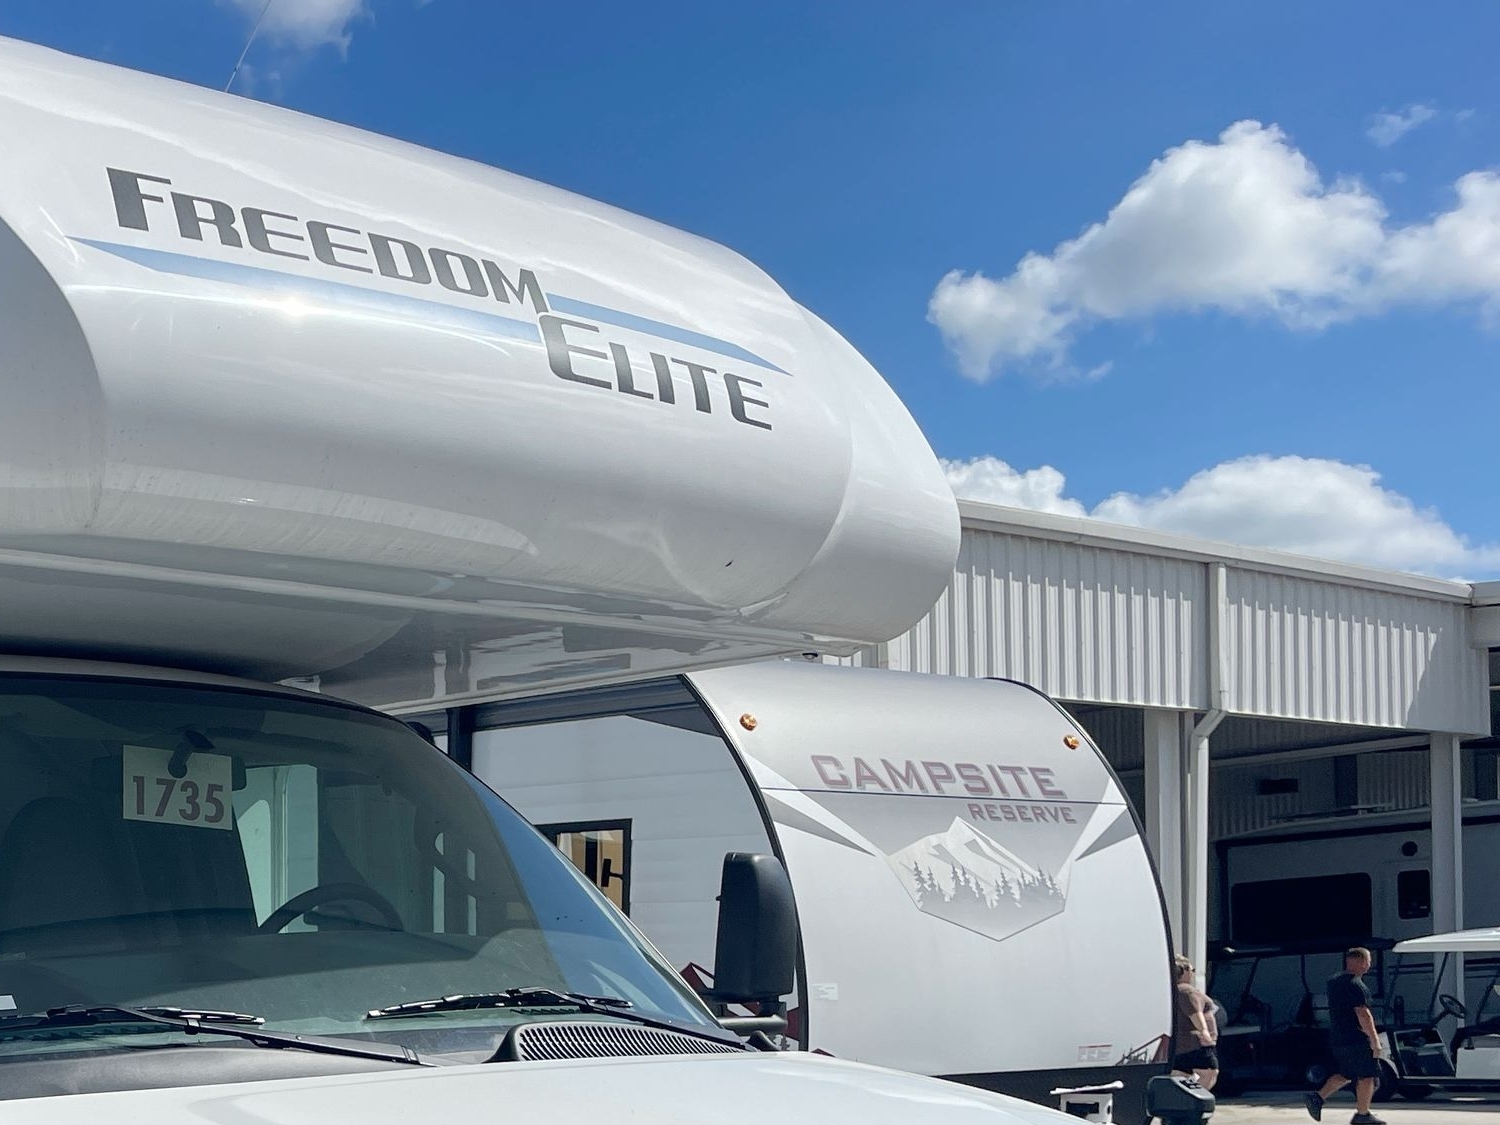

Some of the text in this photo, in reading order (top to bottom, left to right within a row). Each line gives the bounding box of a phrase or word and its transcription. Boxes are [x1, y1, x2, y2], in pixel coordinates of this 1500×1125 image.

[106, 167, 552, 314] FREEDOM
[539, 314, 773, 430] ELITE
[132, 775, 225, 823] 1735
[810, 754, 1068, 799] CAMPSITE
[967, 803, 1077, 824] RESERVE
